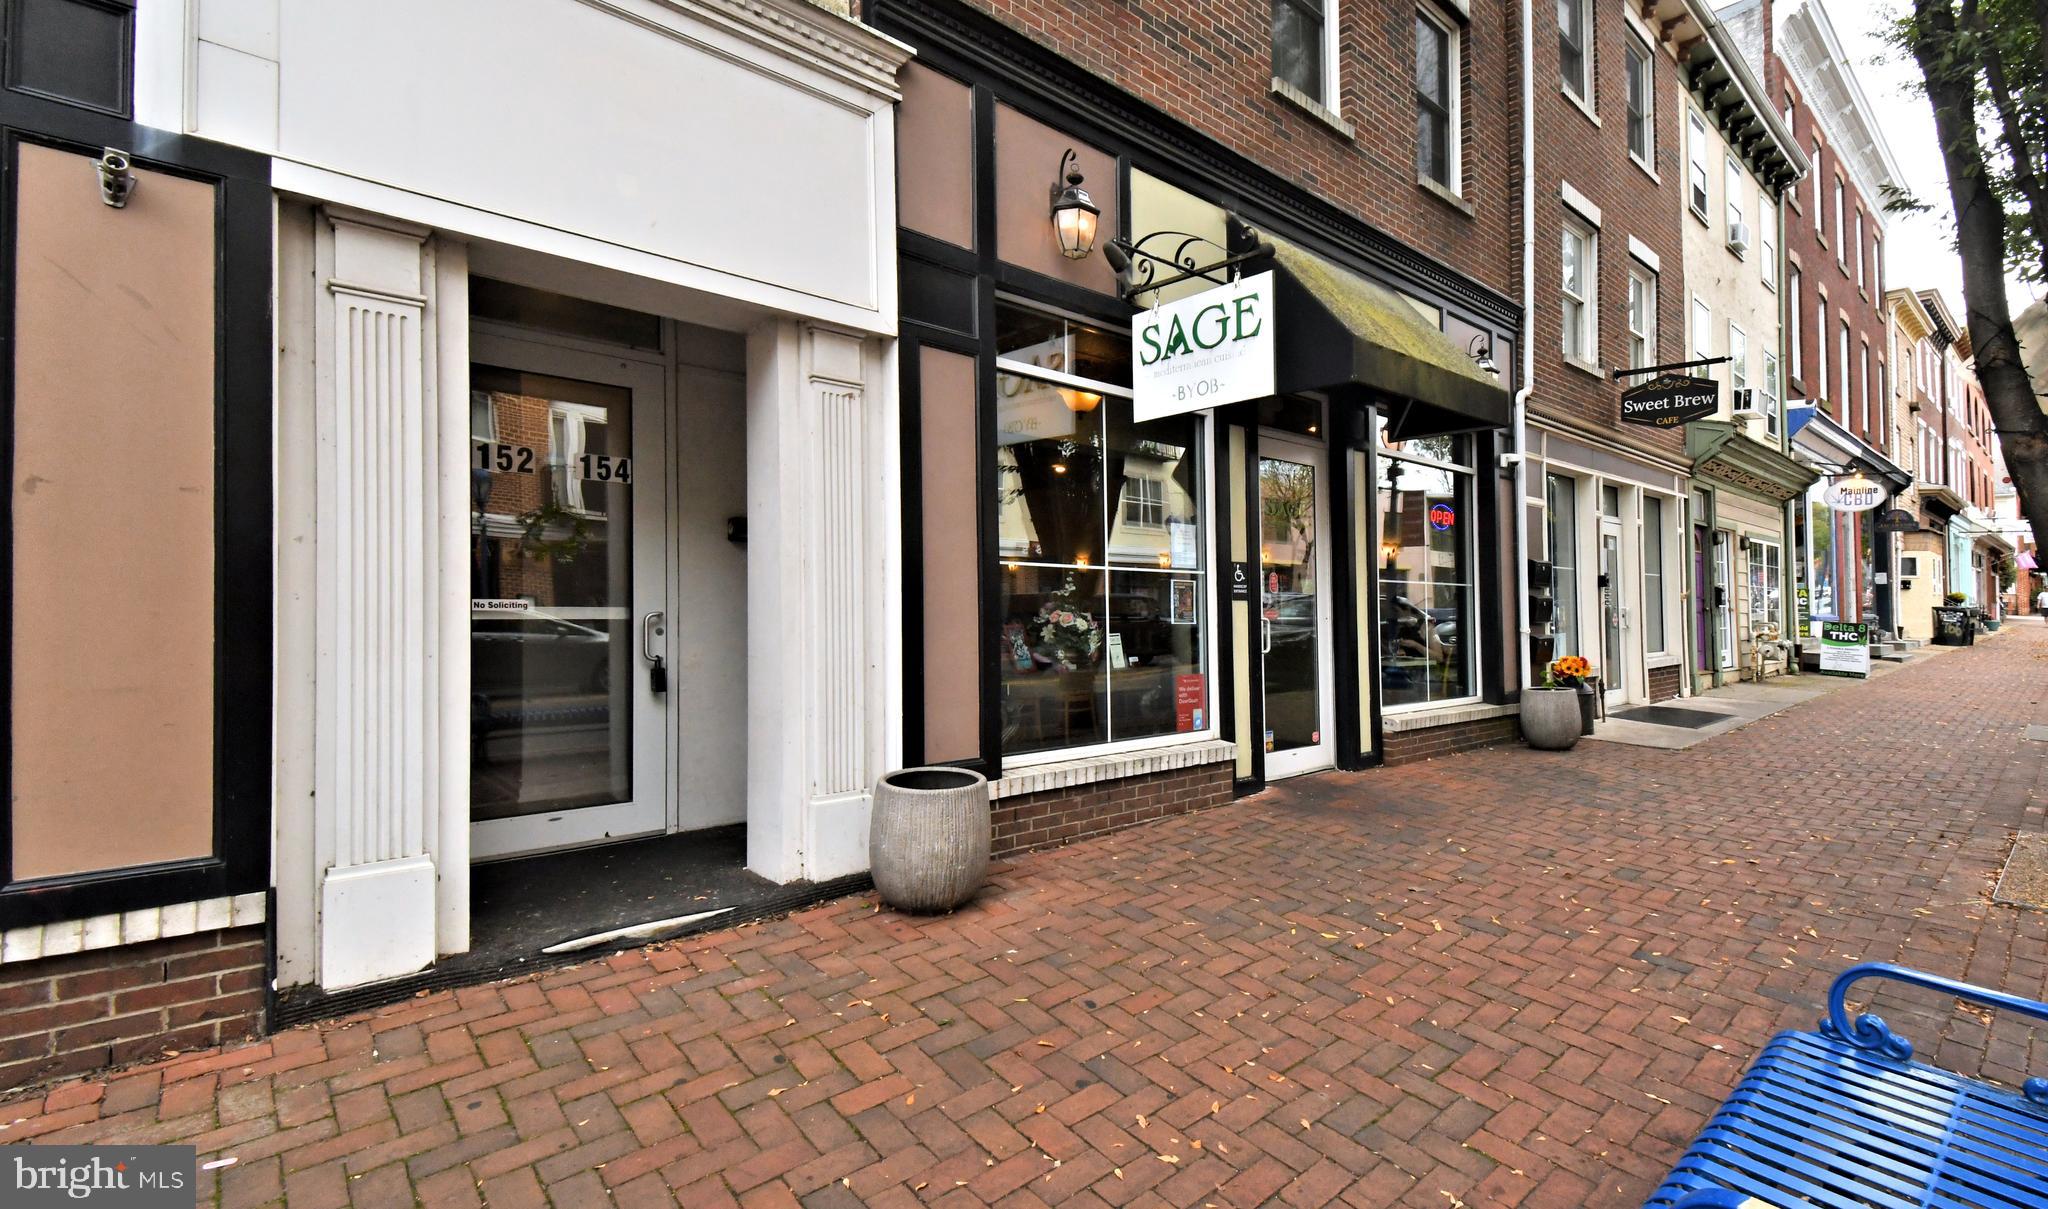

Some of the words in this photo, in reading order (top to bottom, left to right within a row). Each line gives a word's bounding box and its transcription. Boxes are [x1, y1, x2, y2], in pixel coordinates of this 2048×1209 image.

[1140, 293, 1262, 366] SAGE
[1624, 397, 1670, 413] Sweet
[1675, 394, 1715, 408] Brew
[1656, 416, 1679, 425] CAFE
[476, 443, 534, 474] 152
[579, 455, 630, 482] 154
[1840, 487, 1879, 495] Mainline
[1844, 493, 1873, 506] CBD
[1430, 510, 1455, 526] OPEN
[473, 601, 486, 609] No
[488, 601, 529, 611] Soliciting
[1823, 622, 1855, 632] Delta
[1858, 624, 1866, 633] 8
[1829, 631, 1859, 641] THC
